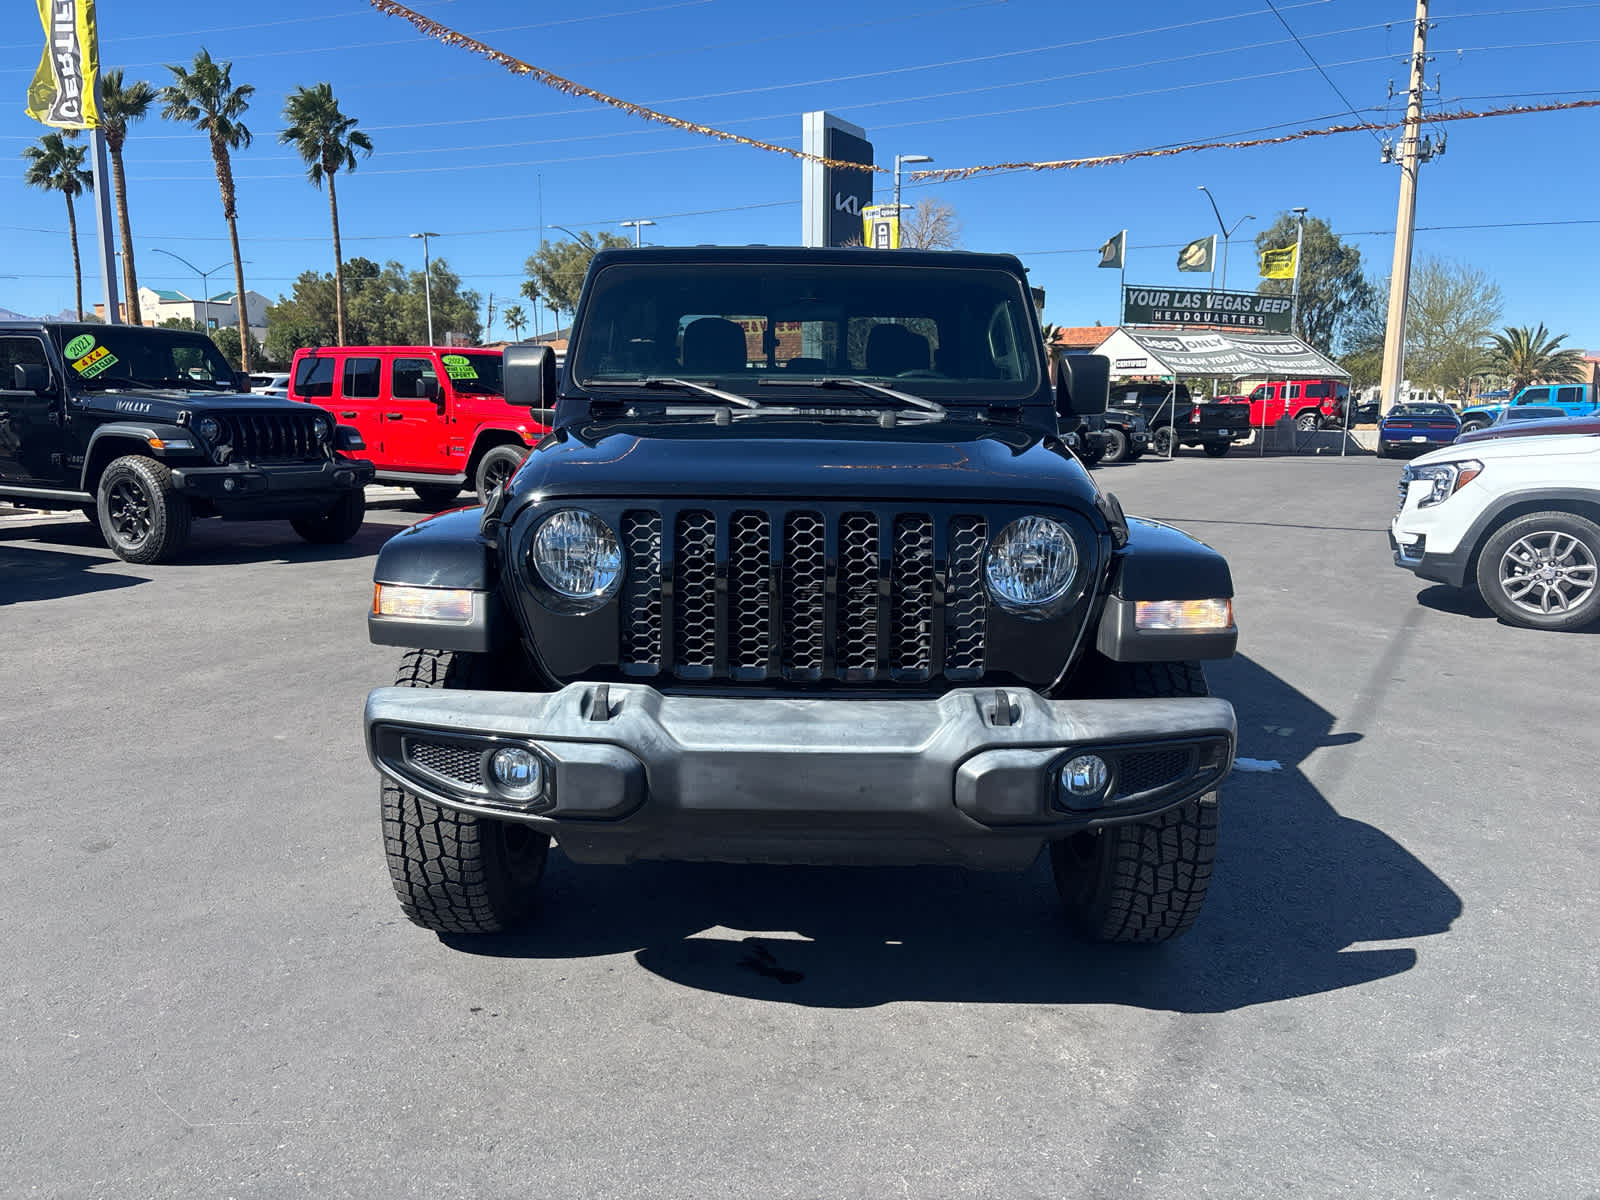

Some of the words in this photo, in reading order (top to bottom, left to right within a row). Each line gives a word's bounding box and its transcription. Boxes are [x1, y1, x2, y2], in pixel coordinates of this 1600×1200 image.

[1128, 290, 1170, 307] YOUR
[1172, 293, 1202, 309] LAS
[1206, 294, 1252, 312] VEGAS
[1254, 299, 1291, 313] JEEP
[1154, 311, 1264, 325] HEADQUARTERS
[70, 336, 92, 357] 2021
[1143, 337, 1183, 352] Jeep
[1185, 338, 1224, 350] ONLY
[82, 364, 101, 378] EXTRA
[98, 356, 117, 370] CLEAN
[115, 399, 152, 413] WILLYS
